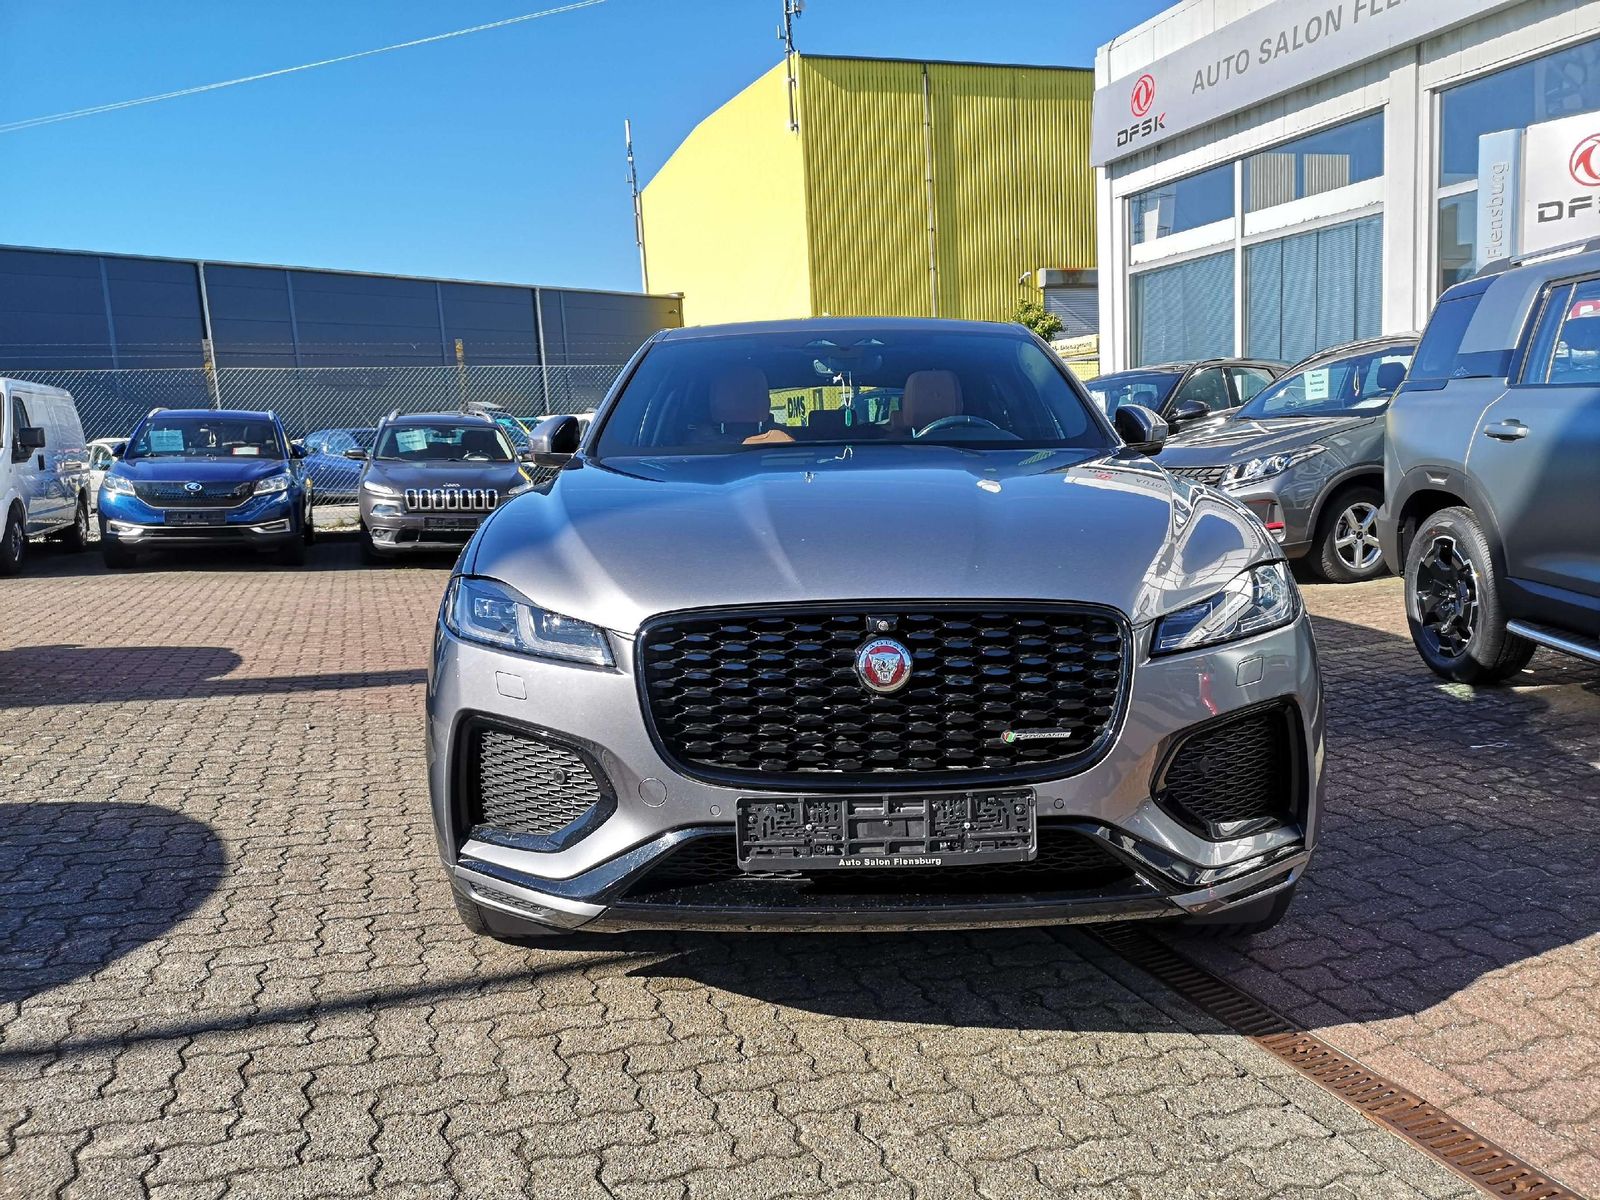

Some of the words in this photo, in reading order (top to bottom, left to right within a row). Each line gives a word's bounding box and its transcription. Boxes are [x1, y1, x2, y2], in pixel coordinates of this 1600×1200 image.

[1191, 48, 1250, 95] AUTO
[1258, 5, 1343, 65] SALON
[1117, 112, 1166, 147] DFSK
[1484, 161, 1510, 259] Flensburg
[1537, 194, 1600, 224] DF
[838, 858, 862, 866] Auto
[864, 858, 891, 866] Salon
[893, 857, 942, 866] Flensburg
